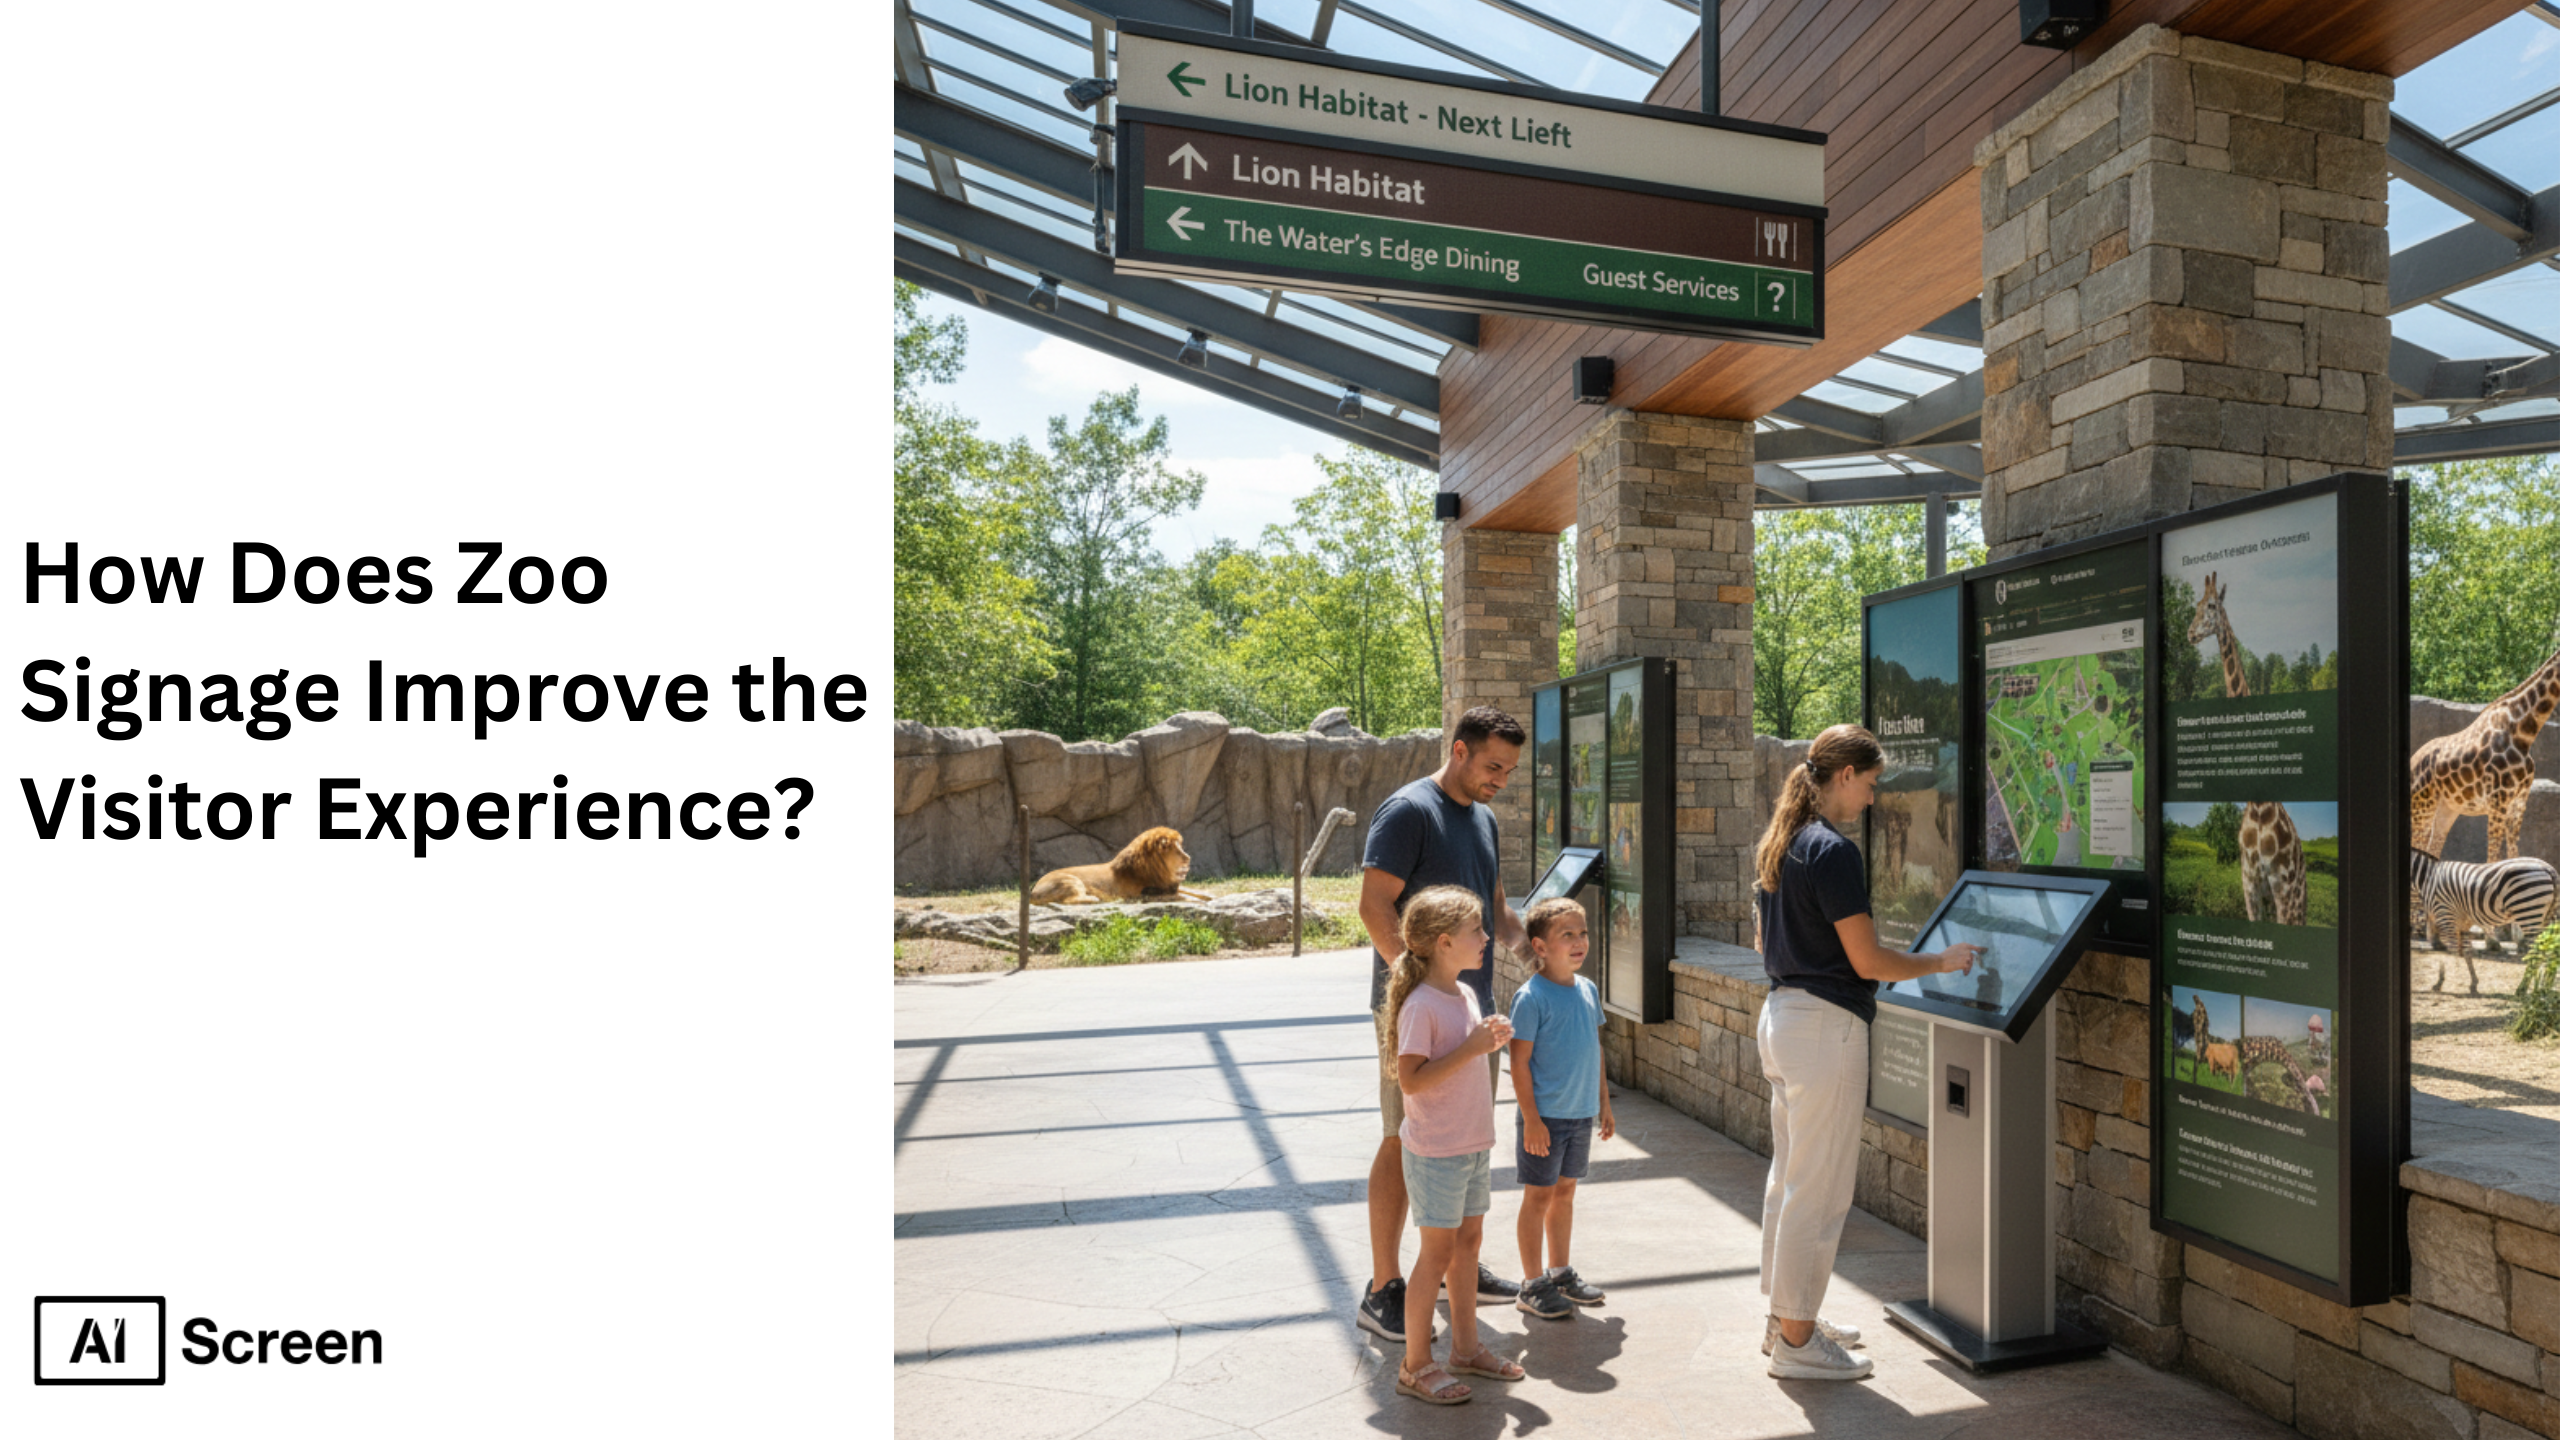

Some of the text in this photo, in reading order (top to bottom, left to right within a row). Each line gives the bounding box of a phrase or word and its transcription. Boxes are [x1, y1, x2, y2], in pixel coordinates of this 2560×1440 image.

[1225, 72, 1572, 149] Lion Habitat - Next Lieft
[1233, 153, 1426, 206] Lion Habitat
[1224, 218, 1521, 283] The Water's Edge Dining
[1583, 262, 1741, 302] Guest Services
